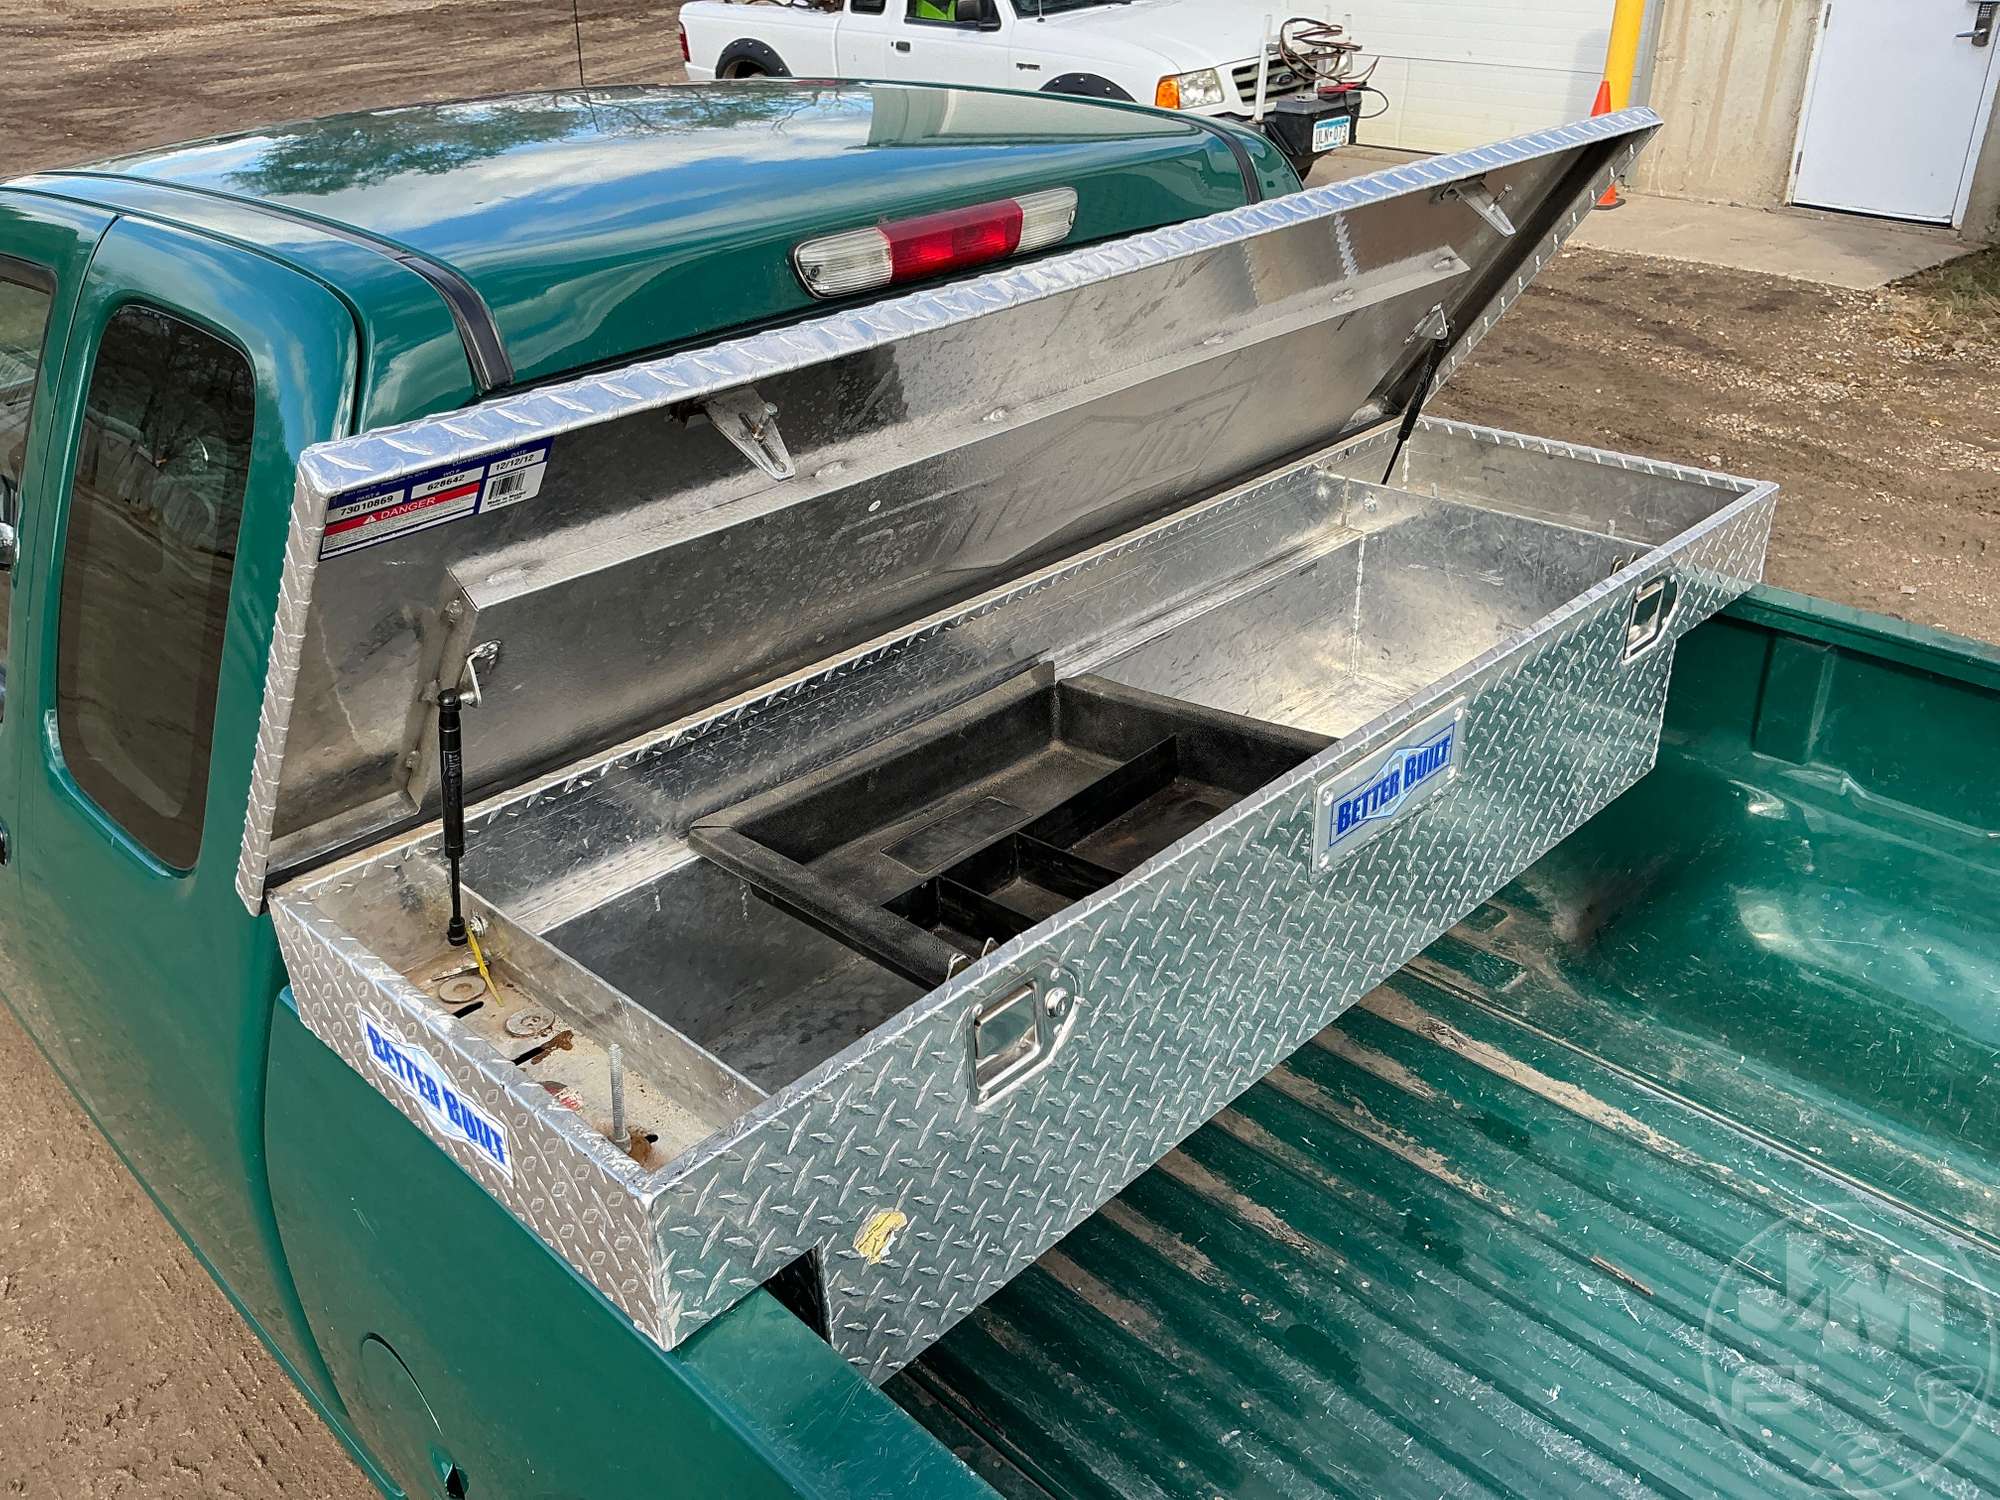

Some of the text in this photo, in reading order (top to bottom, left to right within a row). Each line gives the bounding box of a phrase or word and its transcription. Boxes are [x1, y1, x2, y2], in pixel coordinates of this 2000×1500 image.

[495, 454, 535, 471] 12/12/12
[427, 474, 465, 491] 628642
[341, 495, 394, 516] 73010869
[381, 496, 437, 520] DANGER
[1337, 735, 1451, 835] BETTER BUILT
[366, 1022, 506, 1166] BETTER BUILT
